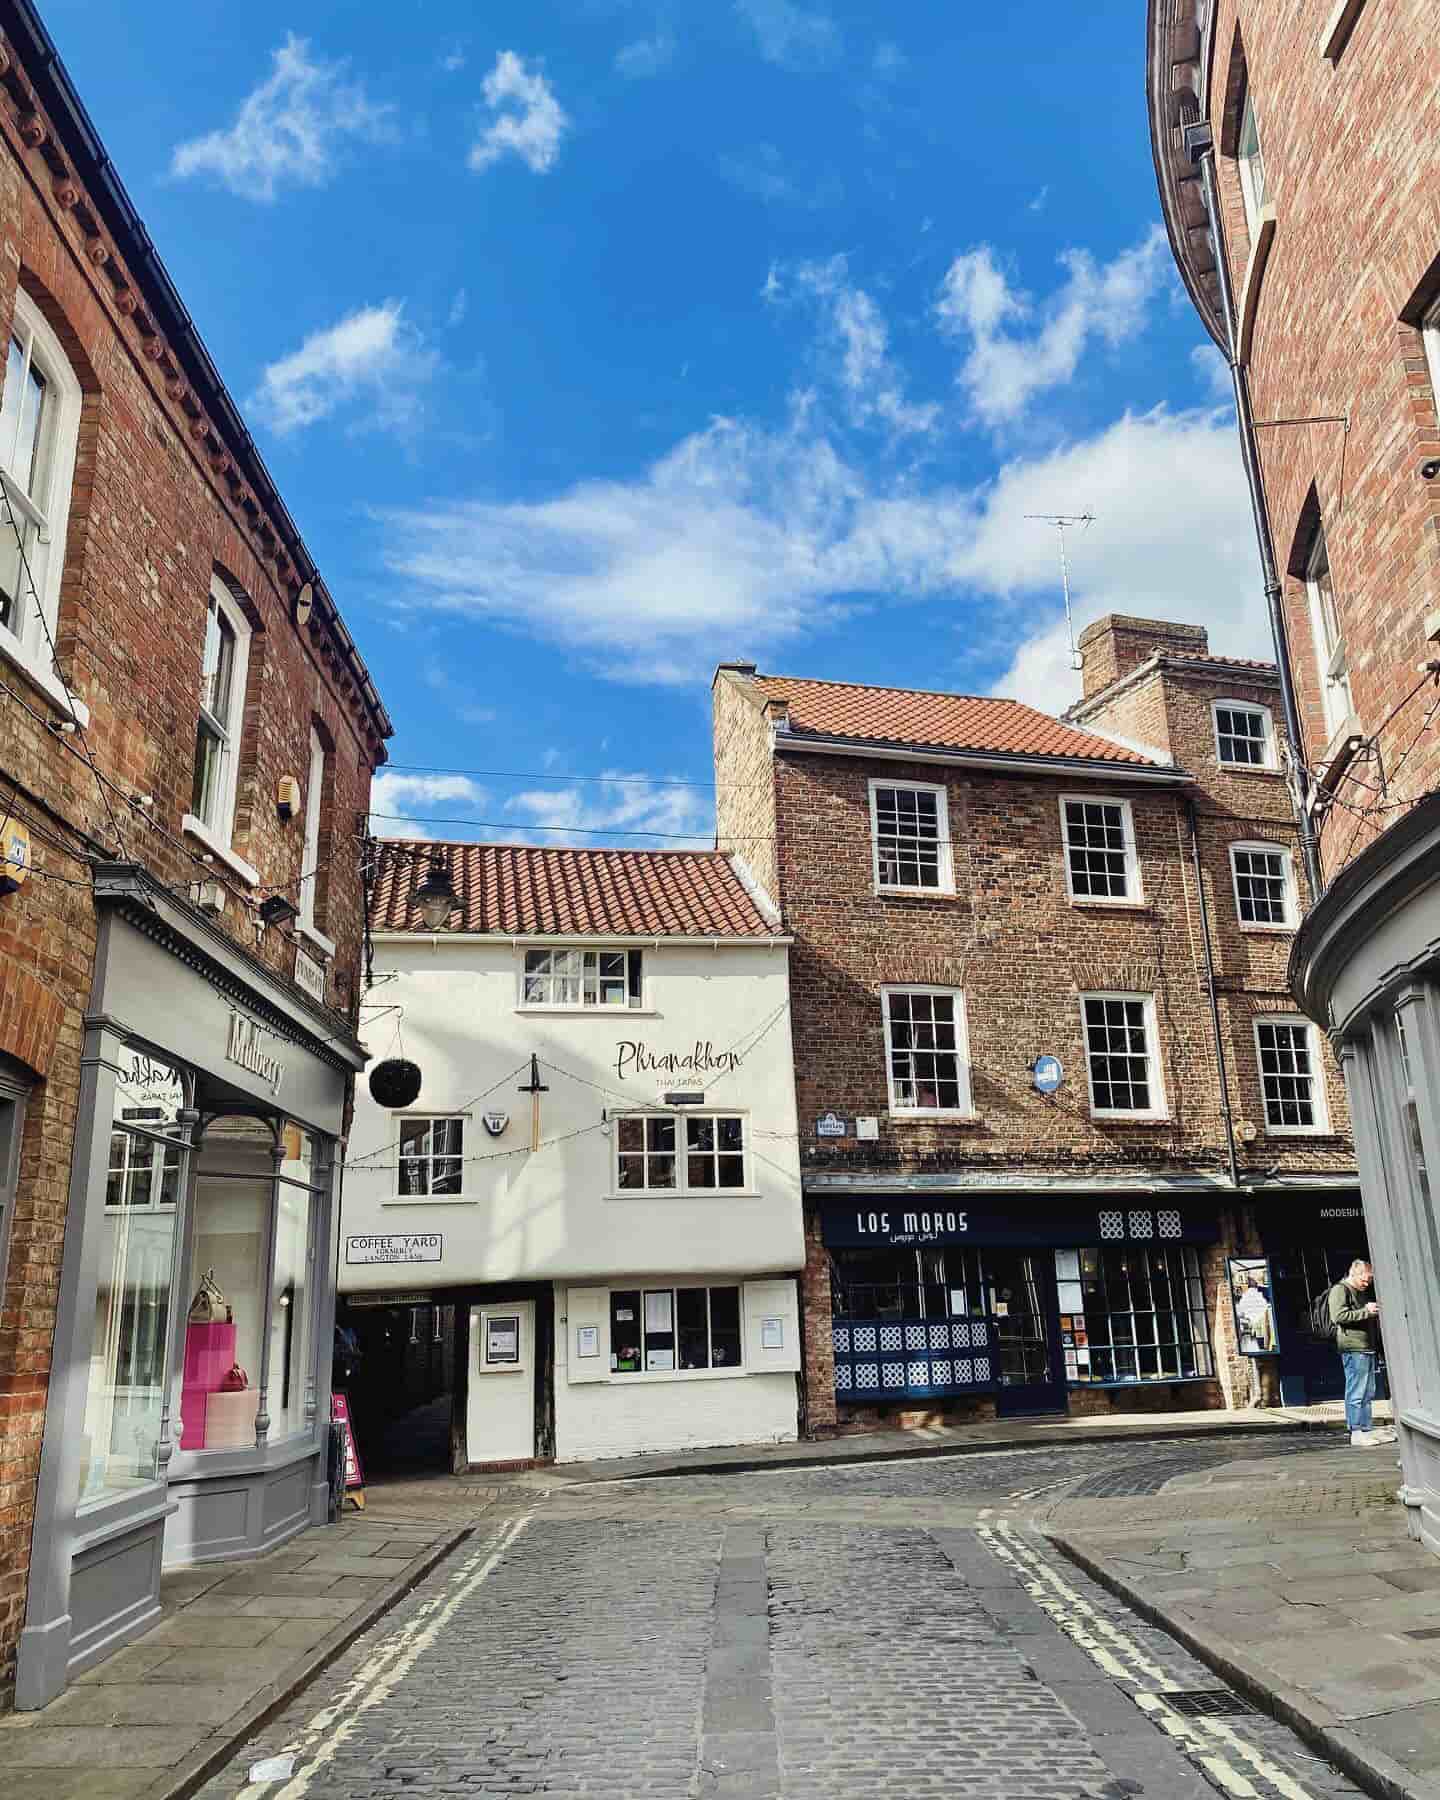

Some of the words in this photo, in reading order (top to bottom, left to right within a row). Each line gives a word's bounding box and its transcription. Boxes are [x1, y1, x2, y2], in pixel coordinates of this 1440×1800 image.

[224, 1011, 287, 1096] Mulberry
[1320, 1208, 1359, 1217] MODERN
[857, 1212, 890, 1233] LOS
[903, 1212, 968, 1233] MOROS
[351, 1238, 393, 1249] COFFEE
[402, 1237, 438, 1248] YARD
